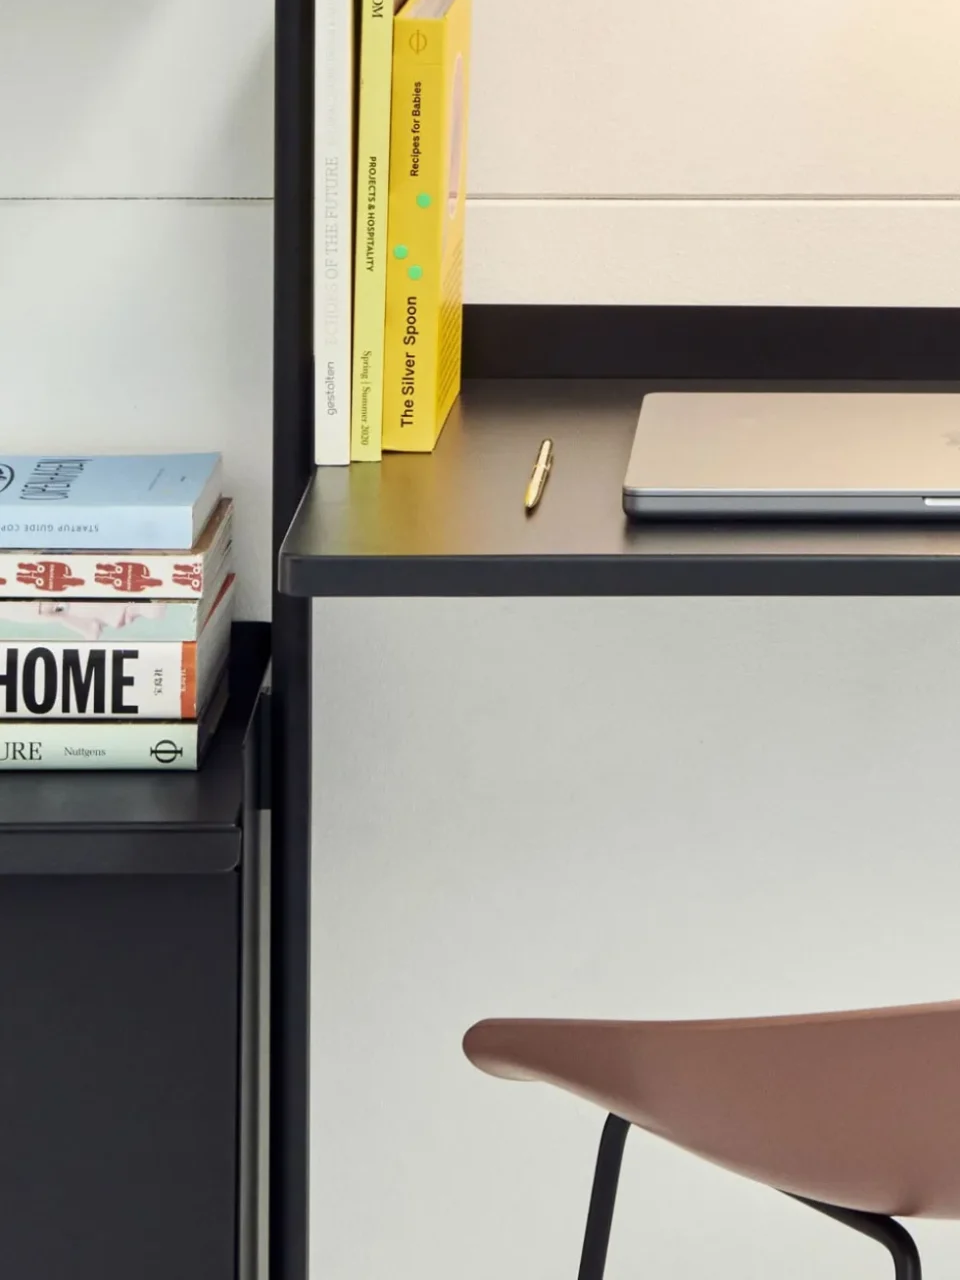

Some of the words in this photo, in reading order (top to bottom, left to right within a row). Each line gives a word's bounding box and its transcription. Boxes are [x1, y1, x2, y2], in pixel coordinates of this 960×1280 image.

[411, 81, 422, 117] Babies
[411, 118, 421, 134] for
[410, 136, 422, 177] Recipes
[325, 156, 339, 220] FUTURE
[367, 156, 377, 202] PROJECTS
[325, 223, 339, 256] THE
[365, 212, 376, 272] HOSPITALITY
[325, 257, 339, 280] OF
[403, 296, 419, 346] Spoon
[360, 350, 373, 380] Spring
[401, 351, 416, 396] Silver
[361, 386, 371, 423] Summer
[400, 399, 413, 428] The
[360, 424, 370, 446] 2020
[23, 523, 54, 533] GUIDE
[57, 523, 100, 533] STARTUP
[63, 746, 107, 758] Nuttgens
